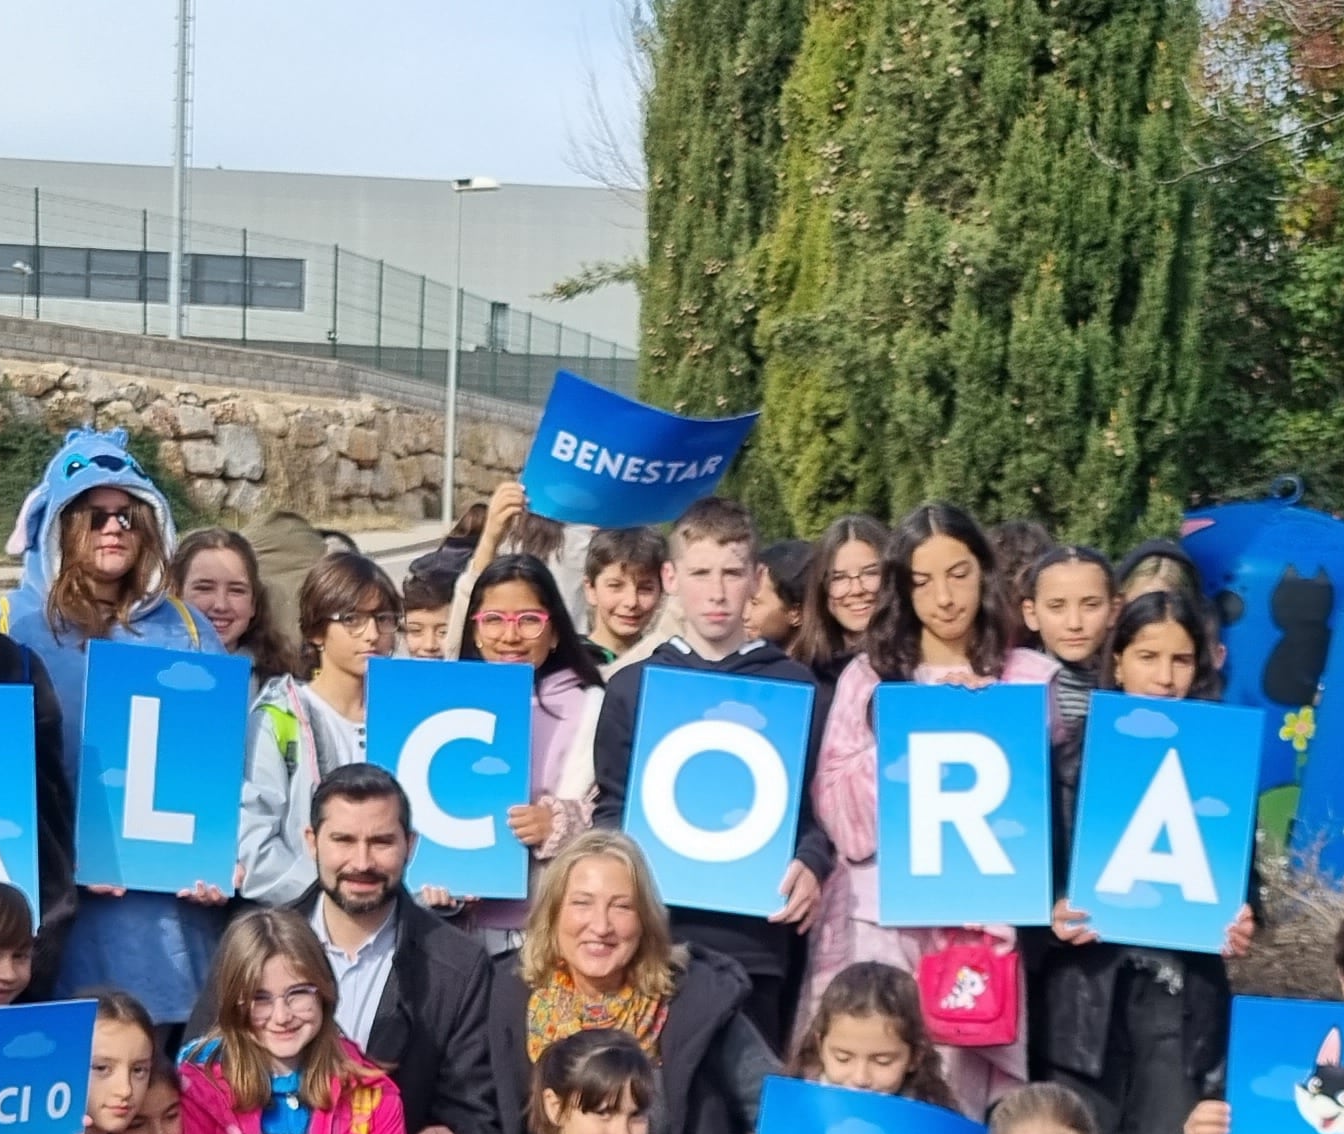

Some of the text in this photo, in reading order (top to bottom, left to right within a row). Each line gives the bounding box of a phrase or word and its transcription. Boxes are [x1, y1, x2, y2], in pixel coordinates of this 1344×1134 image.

[550, 429, 723, 485] BENESTAR
[122, 695, 196, 845] L
[396, 708, 497, 850] C
[641, 719, 789, 864] O
[908, 731, 1015, 877] R
[1095, 746, 1219, 905] A
